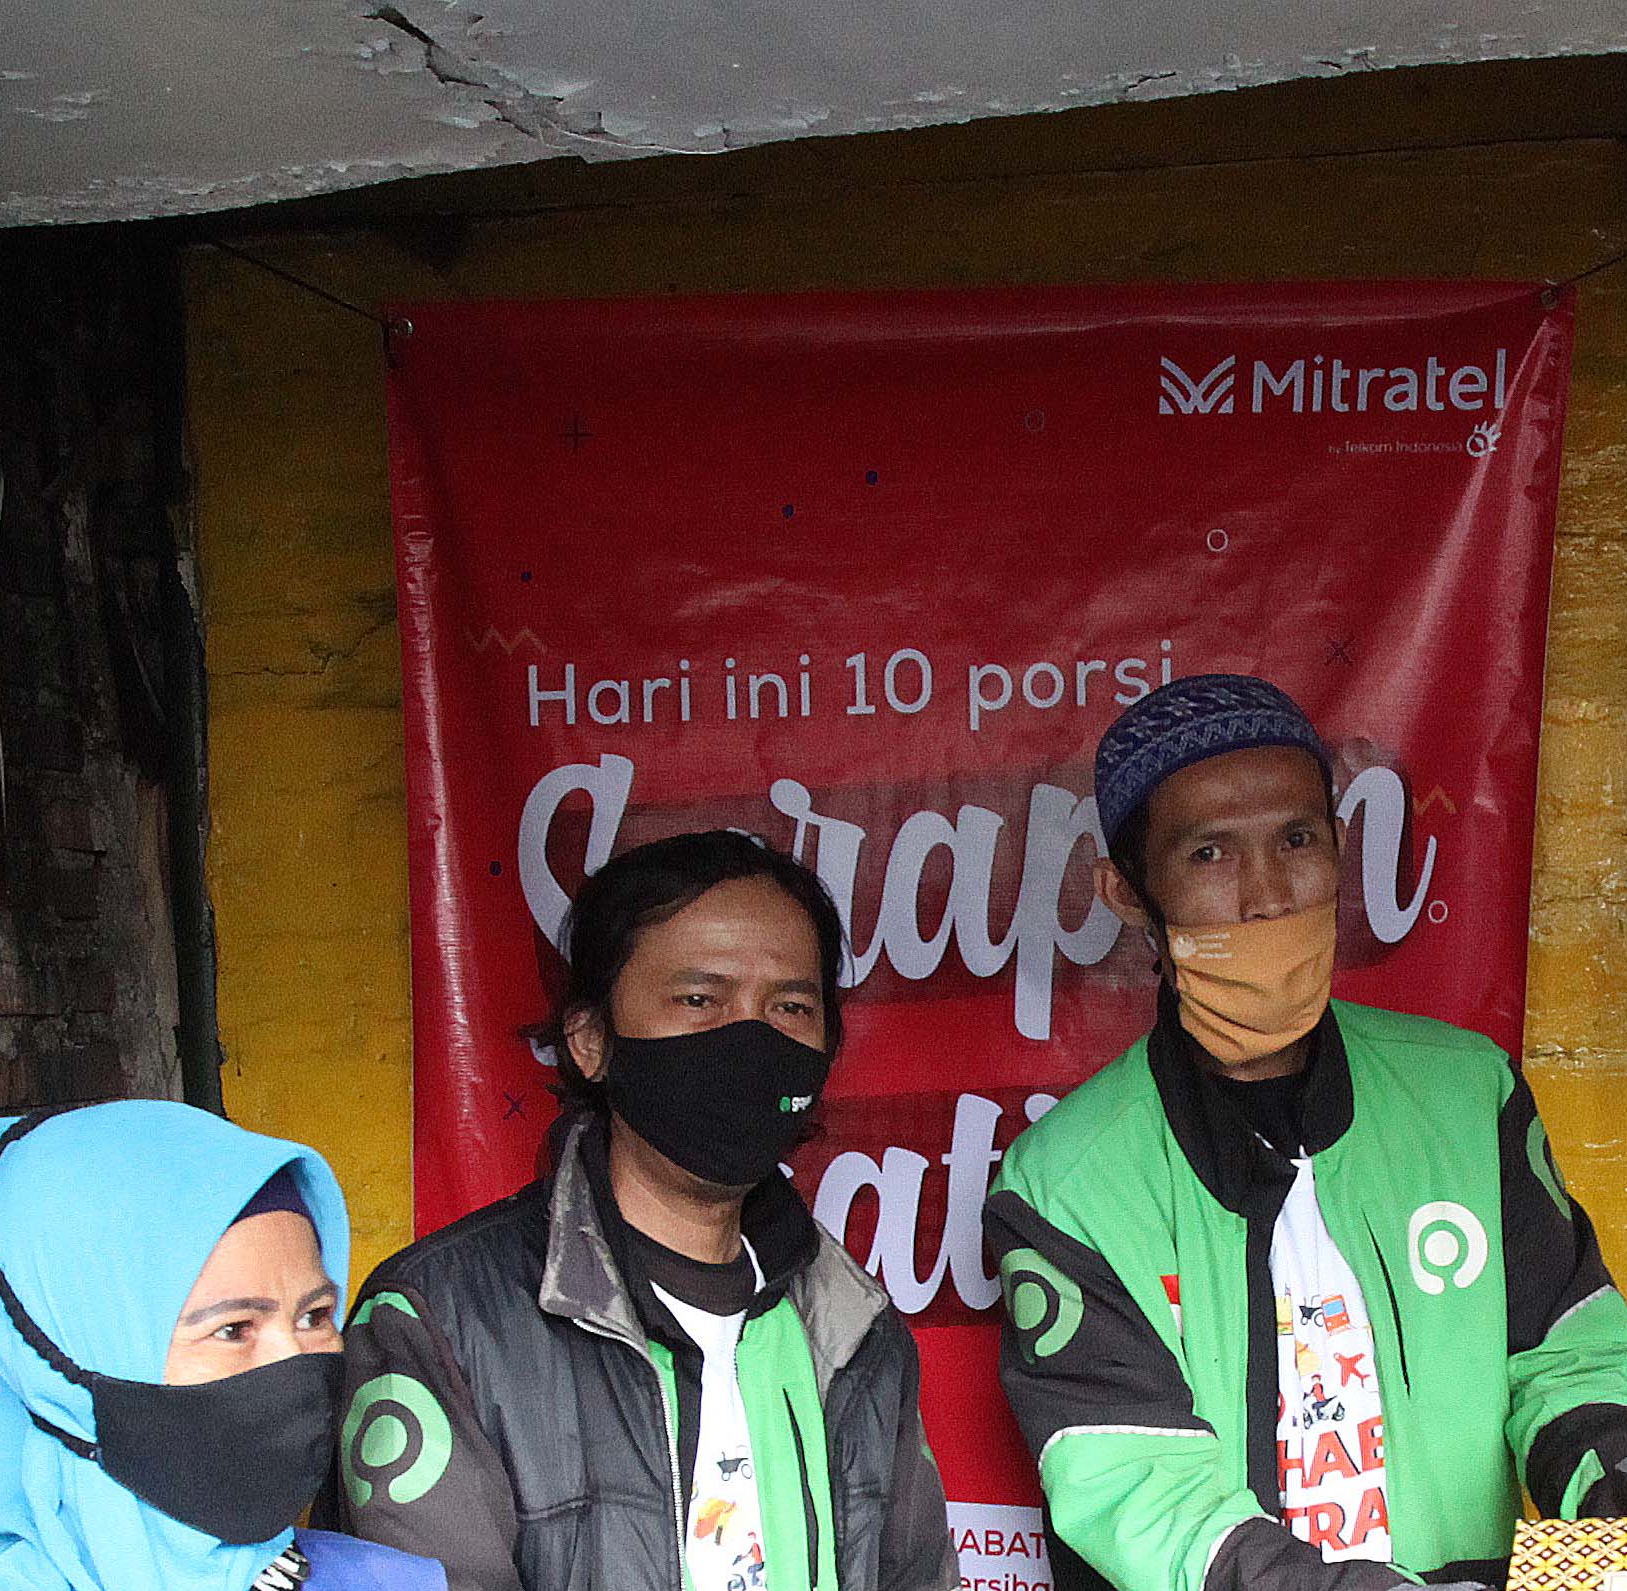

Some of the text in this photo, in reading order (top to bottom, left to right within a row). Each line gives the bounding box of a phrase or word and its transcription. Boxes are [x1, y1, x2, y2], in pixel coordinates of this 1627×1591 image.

[1252, 347, 1507, 414] Mitratel
[528, 639, 1175, 731] Hari ini 10 porsi
